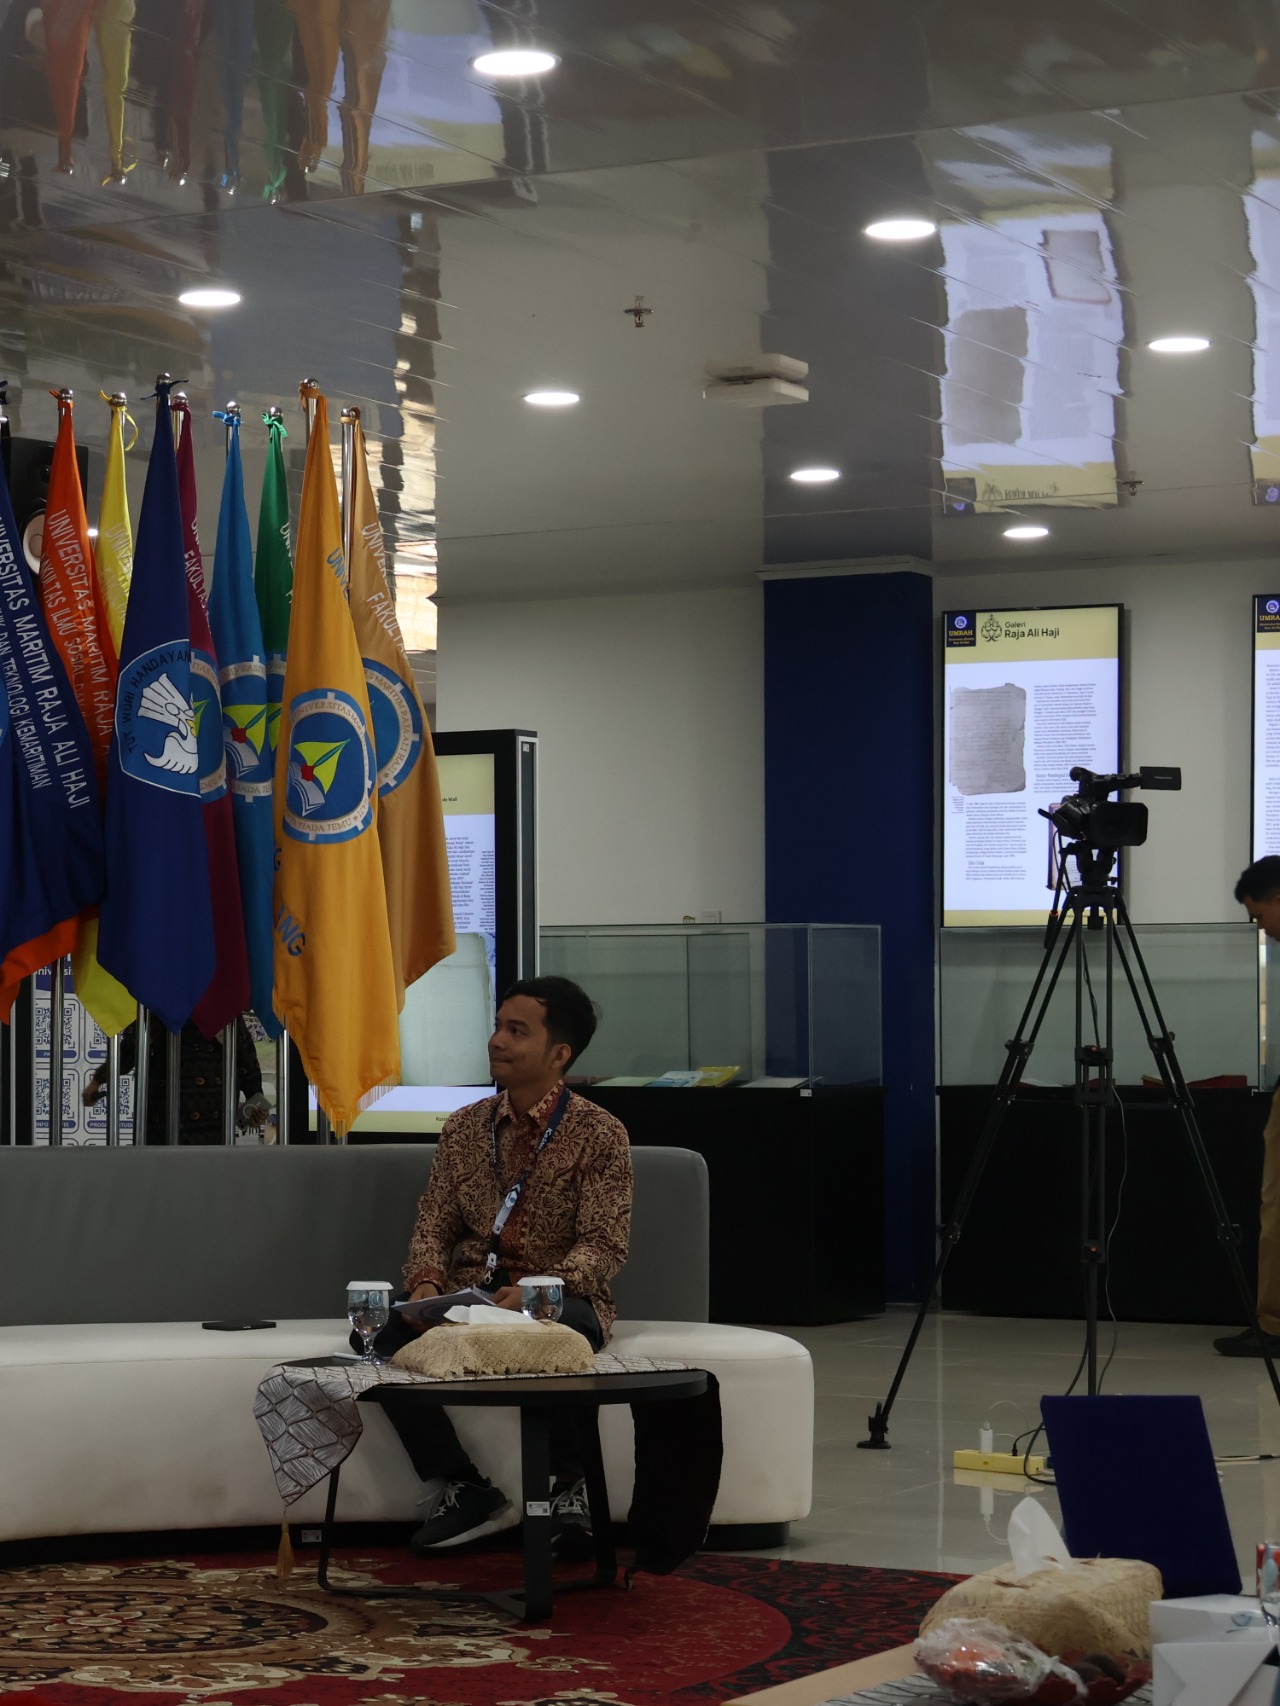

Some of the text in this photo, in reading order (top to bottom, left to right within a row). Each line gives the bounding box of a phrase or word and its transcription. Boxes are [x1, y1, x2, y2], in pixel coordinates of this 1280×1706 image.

[48, 508, 113, 737] UNIVERSITAS MARITIM RAJA
[51, 606, 73, 637] ILMU
[1005, 621, 1027, 629] Galeri
[1005, 627, 1060, 641] Raja Ali Haji
[13, 614, 54, 684] MARITIM
[2, 656, 28, 719] TEKNOLOGI
[35, 687, 68, 735] RAJA
[122, 691, 135, 724] WURI
[13, 716, 52, 791] KEMARITIMAN
[51, 738, 79, 766] ALI
[123, 731, 137, 753] TUT
[60, 767, 90, 809] HAJI
